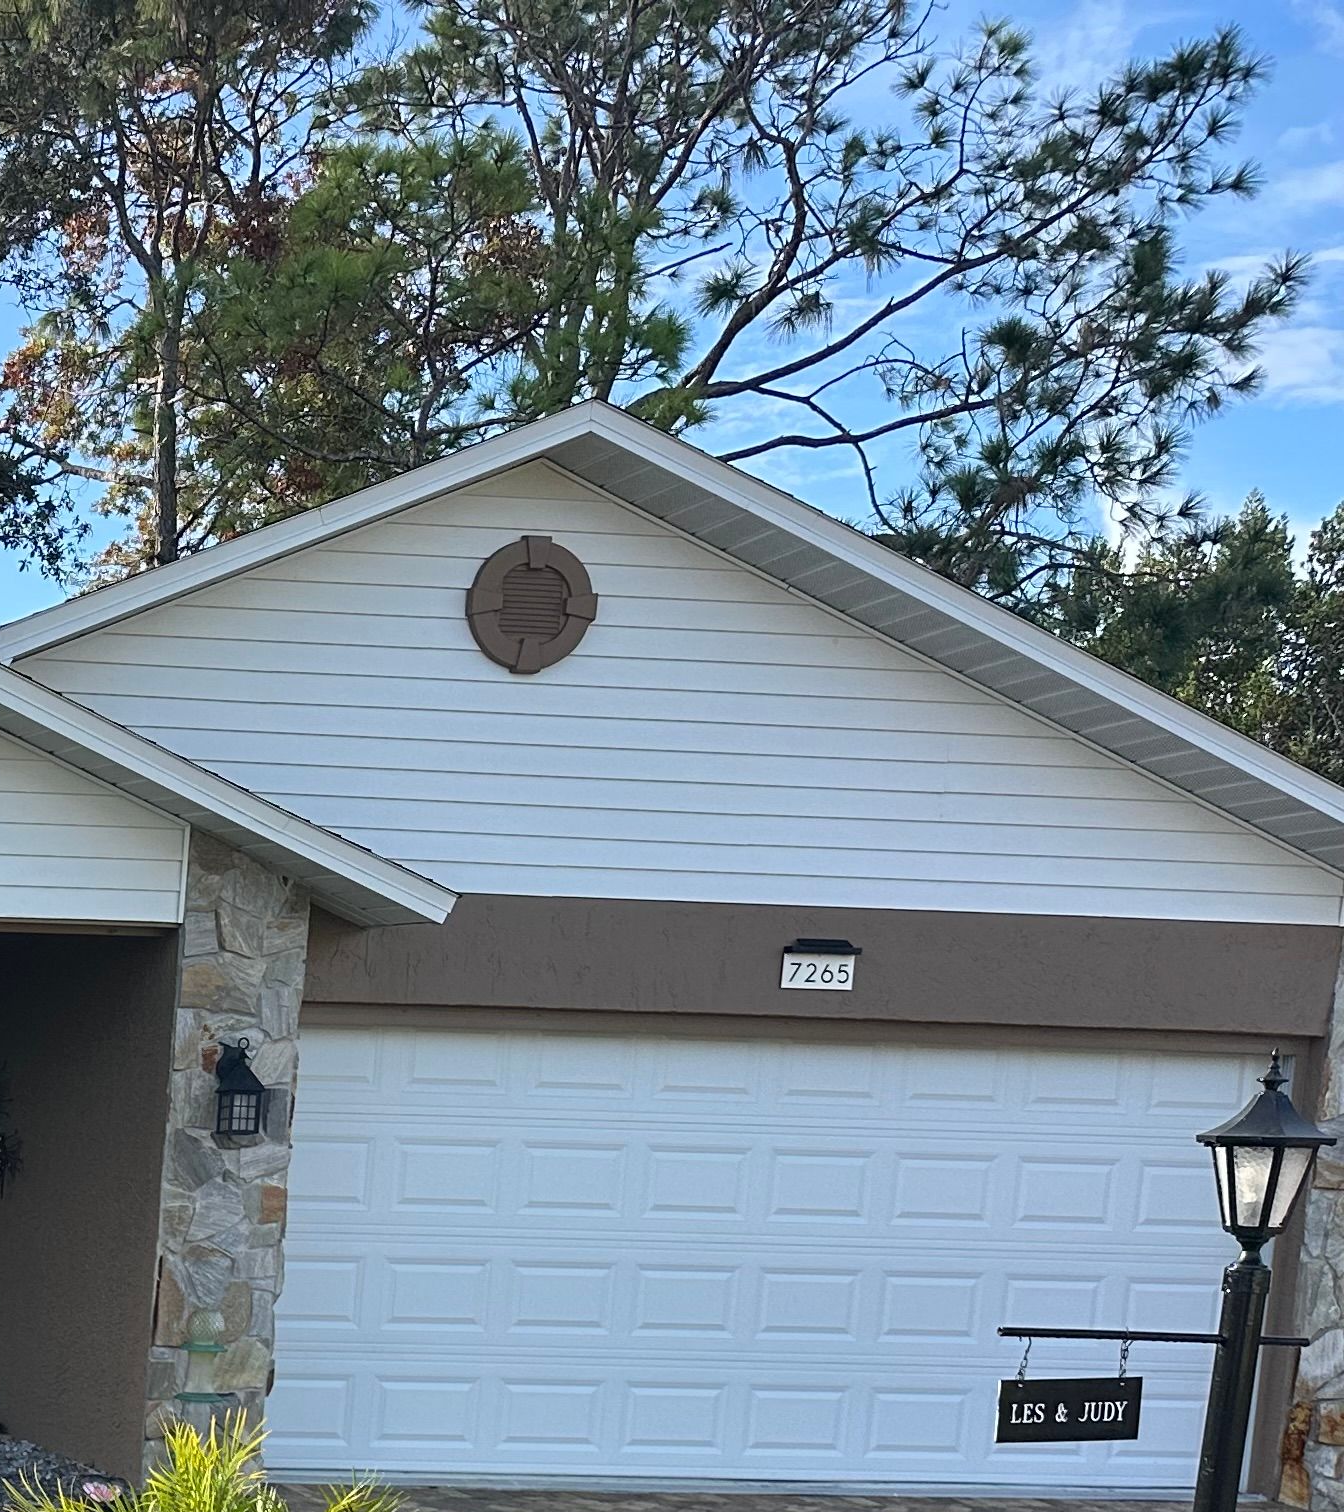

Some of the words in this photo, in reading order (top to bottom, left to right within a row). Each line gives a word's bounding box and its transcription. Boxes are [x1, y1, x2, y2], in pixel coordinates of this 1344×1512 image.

[788, 962, 850, 984] 7265
[1010, 1402, 1046, 1424] LES
[1055, 1402, 1068, 1423] &
[1078, 1400, 1128, 1422] JUDY
